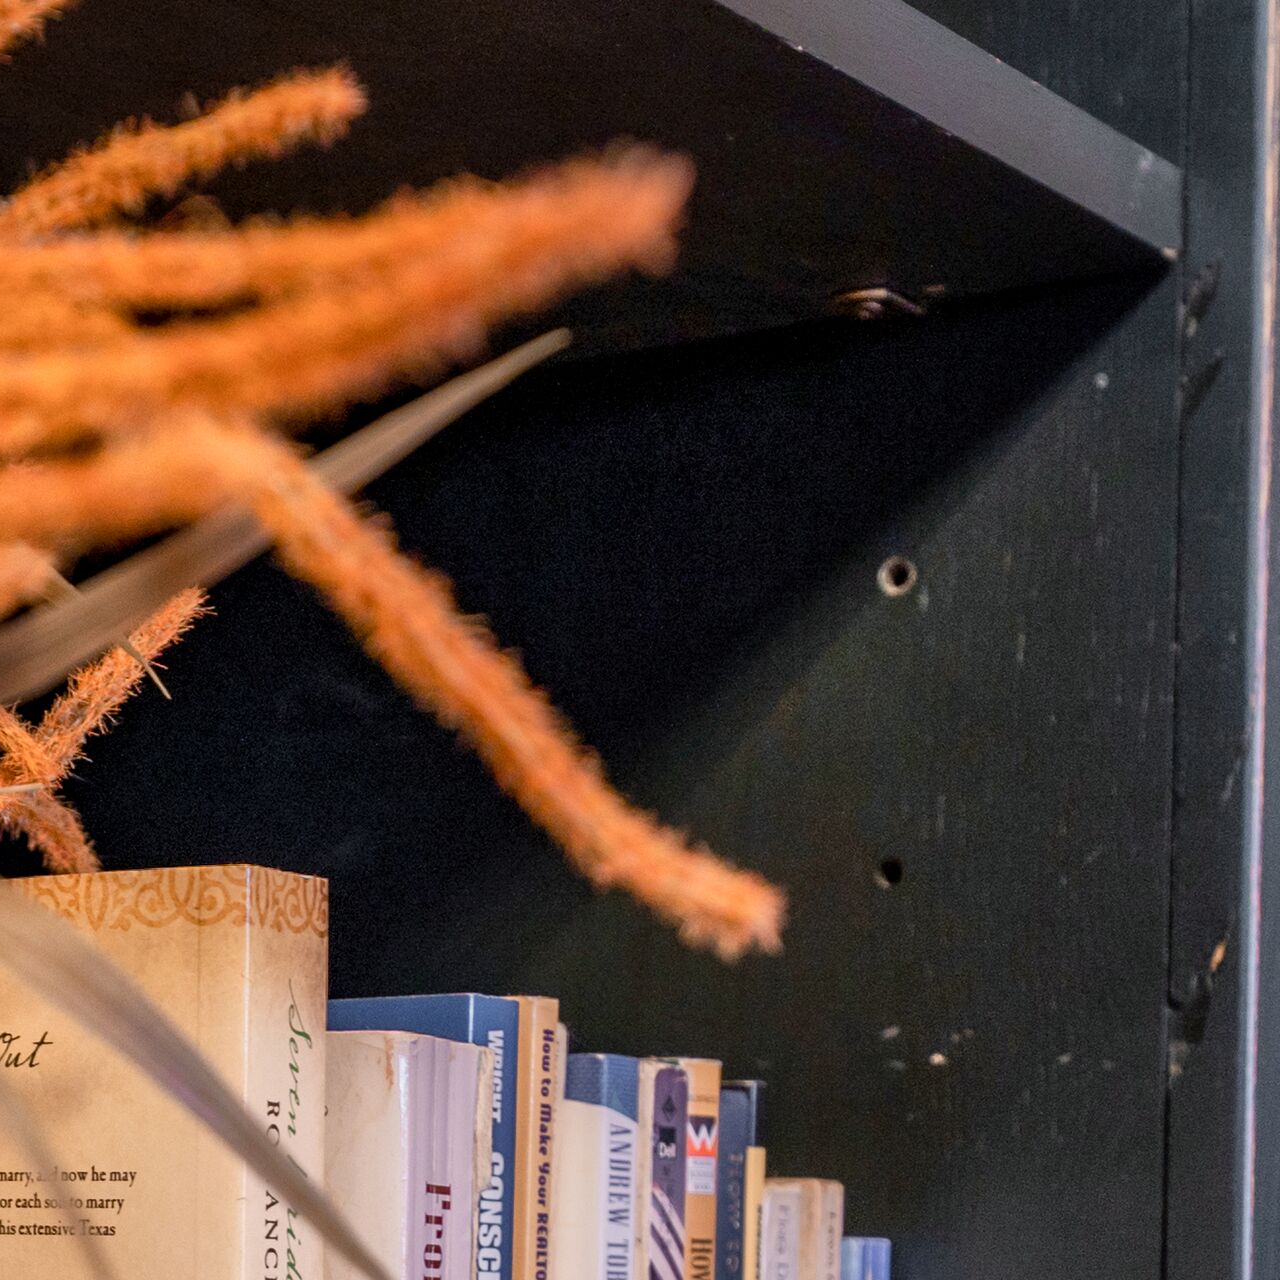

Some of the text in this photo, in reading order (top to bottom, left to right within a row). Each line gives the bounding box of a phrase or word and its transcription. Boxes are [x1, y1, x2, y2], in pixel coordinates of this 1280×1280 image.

[287, 978, 312, 1137] Seven
[542, 1029, 554, 1072] How
[541, 1078, 552, 1097] to
[539, 1104, 552, 1156] Make
[61, 1171, 88, 1183] now
[109, 1171, 137, 1187] may
[607, 1123, 633, 1229] ANDREW
[15, 1193, 42, 1208] each
[86, 1197, 125, 1214] marry
[18, 1220, 76, 1236] extensive
[79, 1219, 116, 1236] Texas
